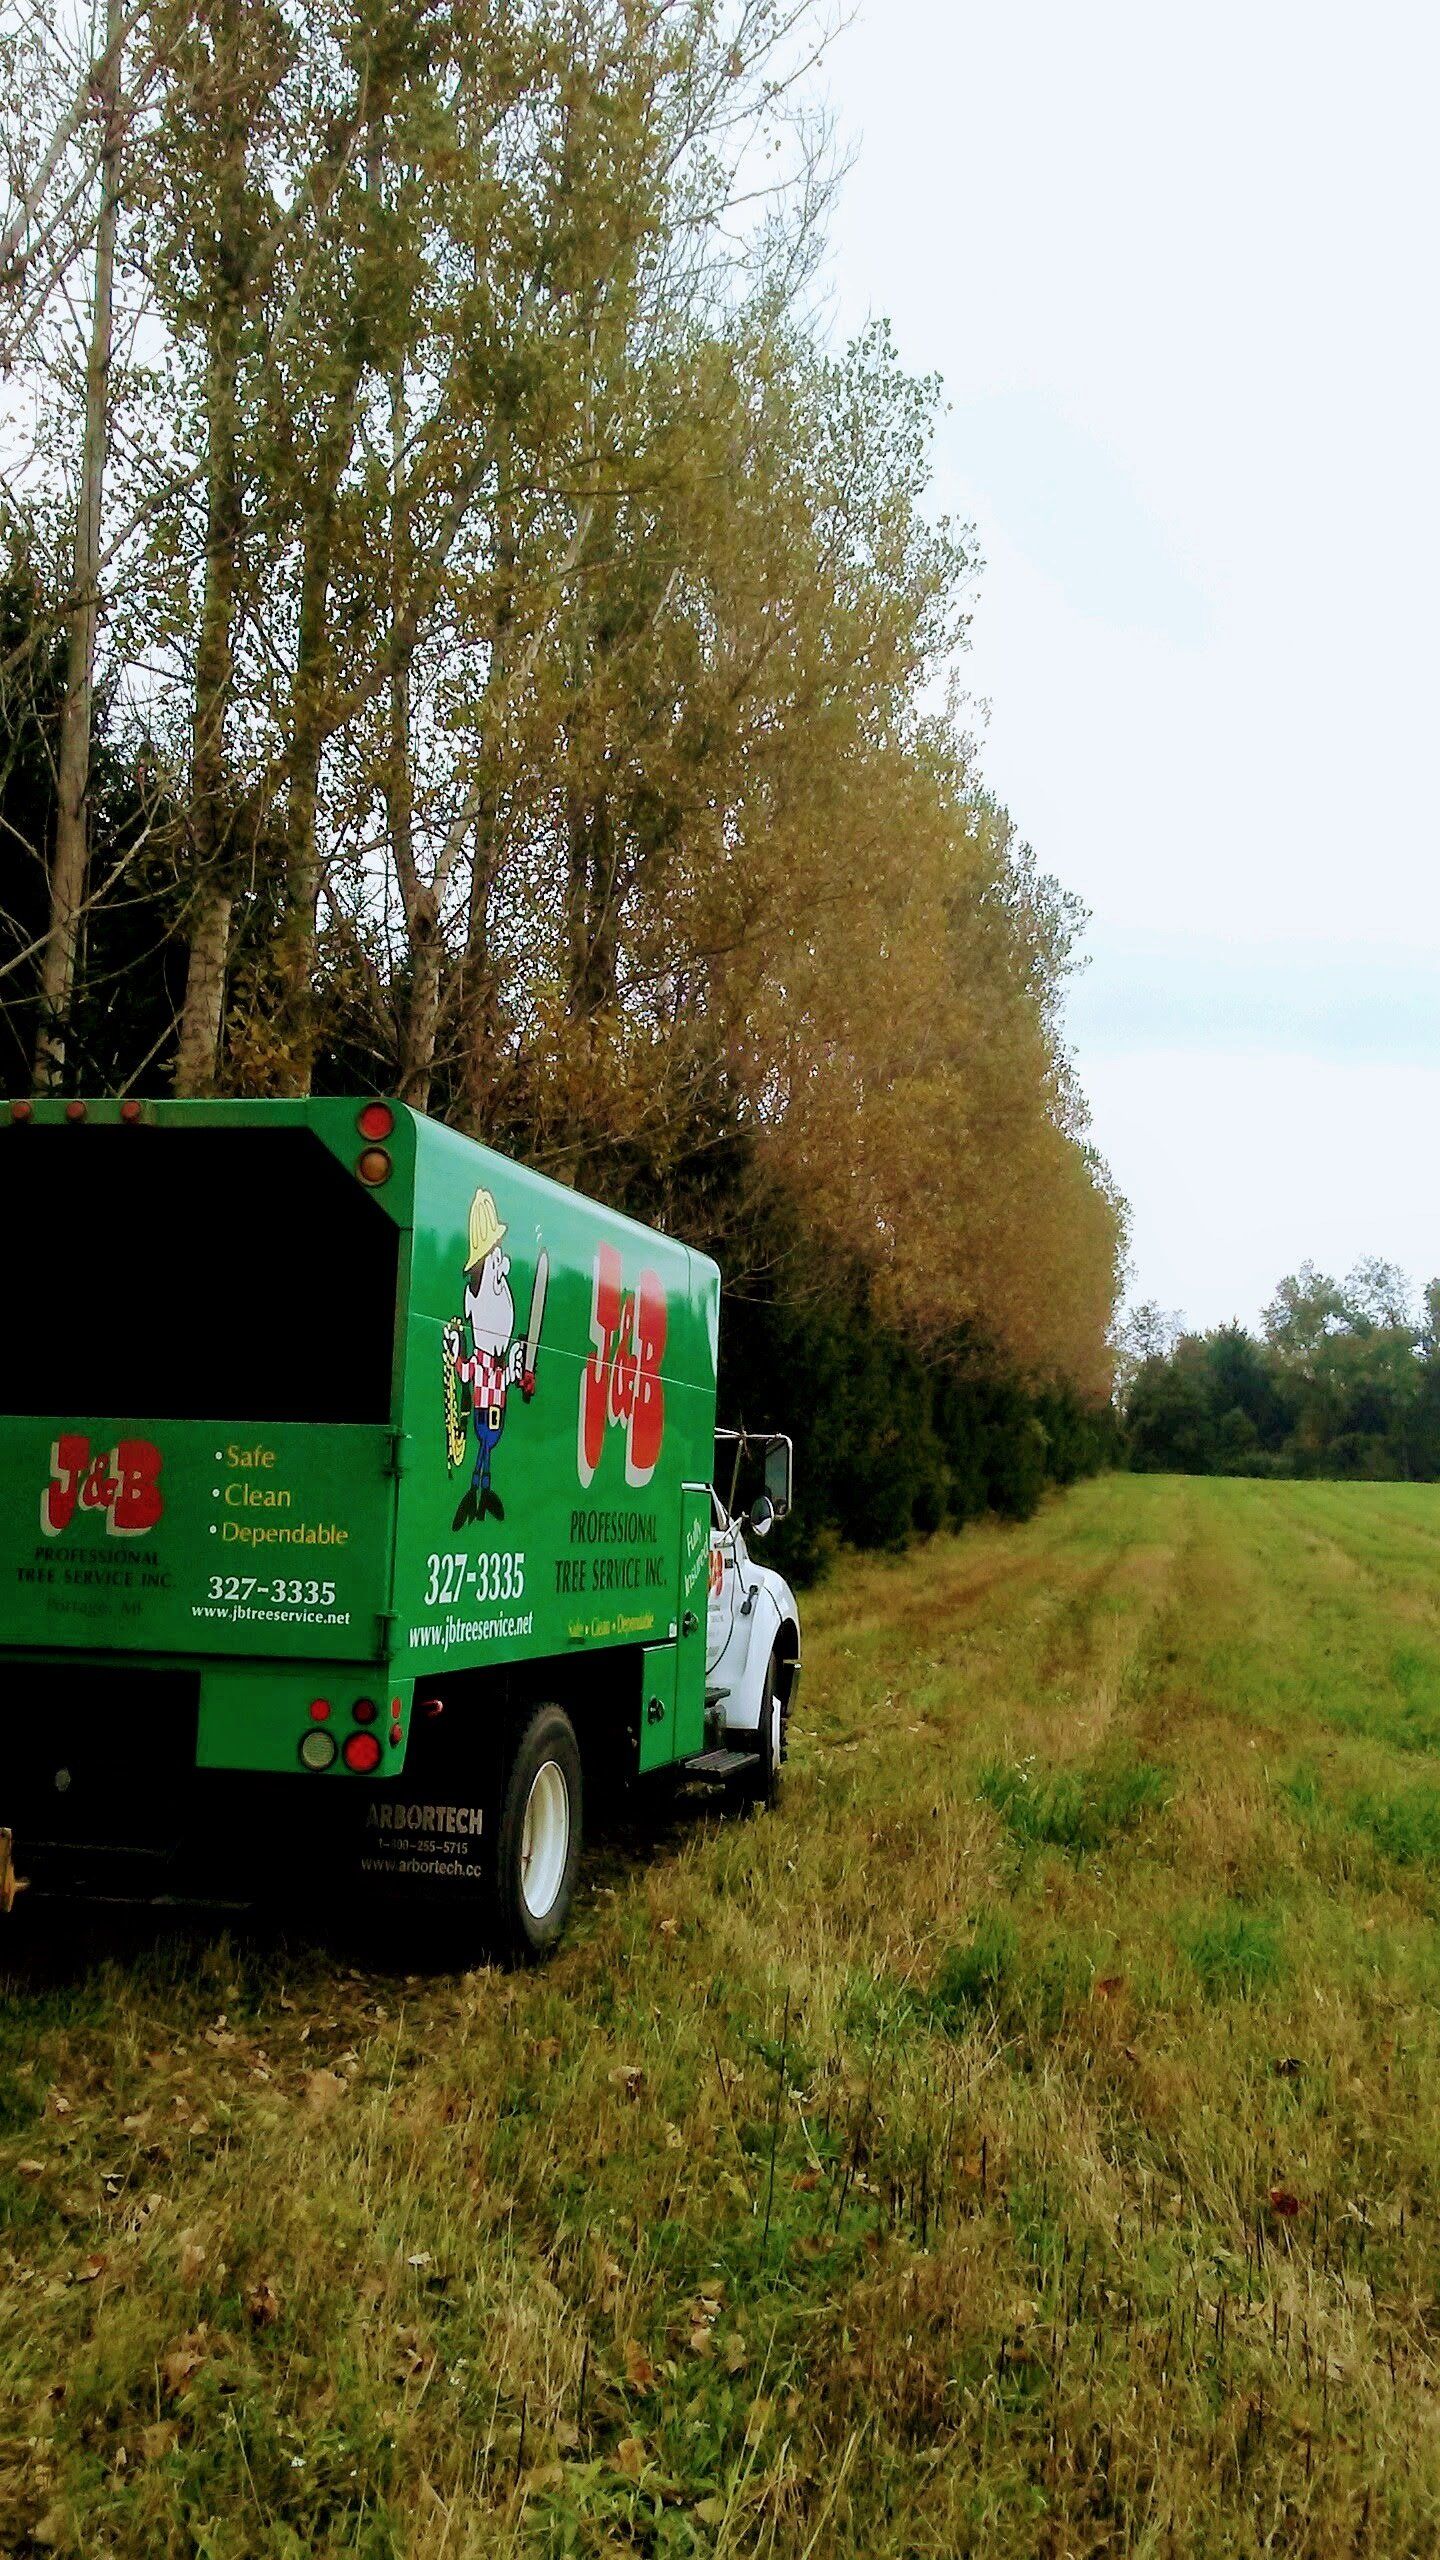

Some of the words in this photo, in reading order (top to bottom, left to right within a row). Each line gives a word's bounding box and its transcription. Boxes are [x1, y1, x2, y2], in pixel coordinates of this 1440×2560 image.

[578, 1239, 668, 1489] J&B
[226, 1445, 277, 1469] Safe
[40, 1433, 164, 1538] J&B
[224, 1483, 292, 1509] Clean
[221, 1521, 349, 1547] Dependable
[569, 1510, 658, 1544] PROFESSIONAL
[33, 1546, 160, 1568] PROFESSIONAL
[16, 1567, 56, 1585] TREE
[64, 1568, 136, 1588] SERVICE
[207, 1575, 337, 1606] 327-3335
[424, 1552, 525, 1606] 327-3335
[555, 1559, 588, 1594] TREE
[592, 1556, 641, 1592] SERVICE
[645, 1555, 668, 1587] INC.
[191, 1603, 350, 1625] www.jbtreeservice.net
[408, 1609, 534, 1654] www.jbtreeservice.net
[365, 1802, 484, 1835] ARBORTECH
